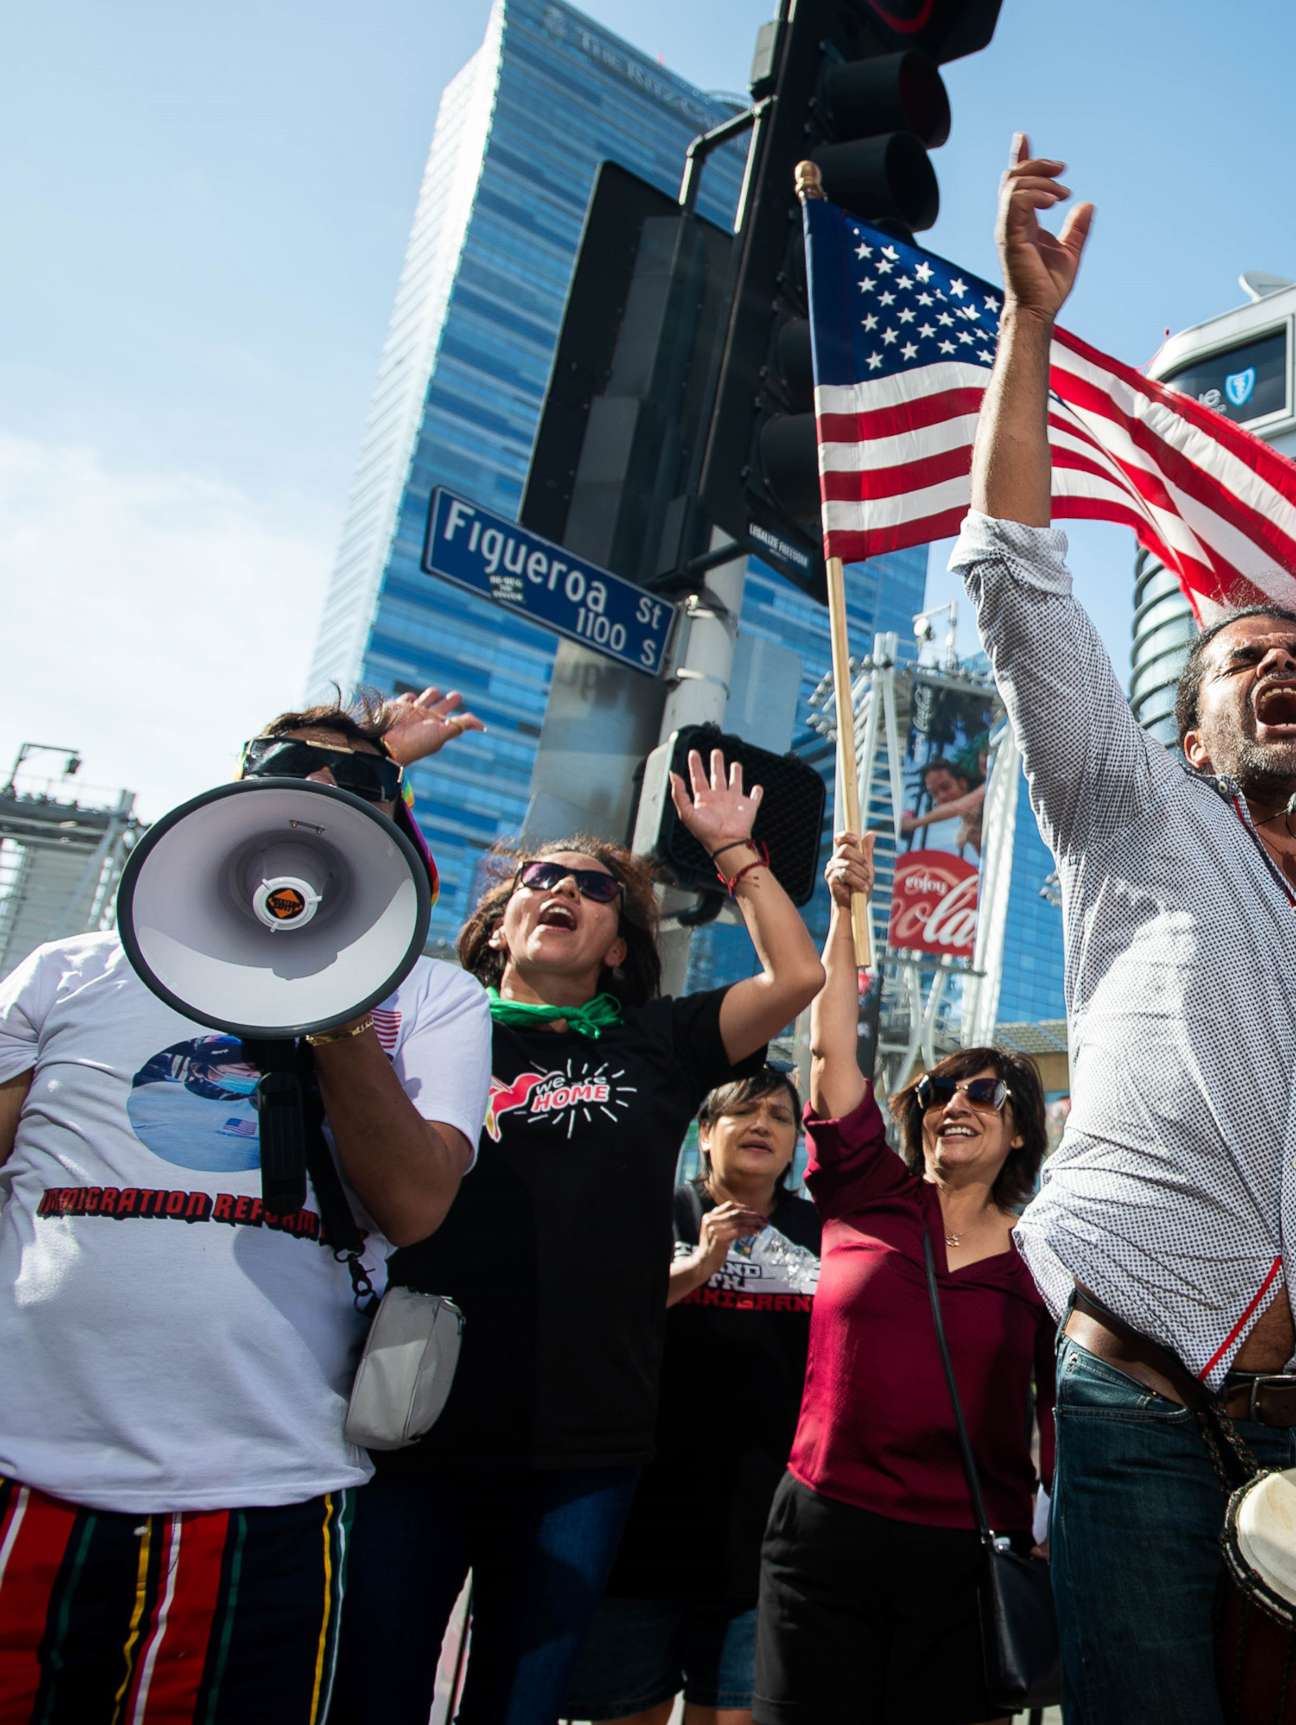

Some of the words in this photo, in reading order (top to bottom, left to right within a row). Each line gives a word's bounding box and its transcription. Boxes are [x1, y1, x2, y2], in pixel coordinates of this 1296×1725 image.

[443, 499, 608, 614] Figueroa
[635, 596, 662, 631] St
[576, 607, 627, 652] 1100
[640, 637, 657, 666] S
[530, 1084, 610, 1113] HOME
